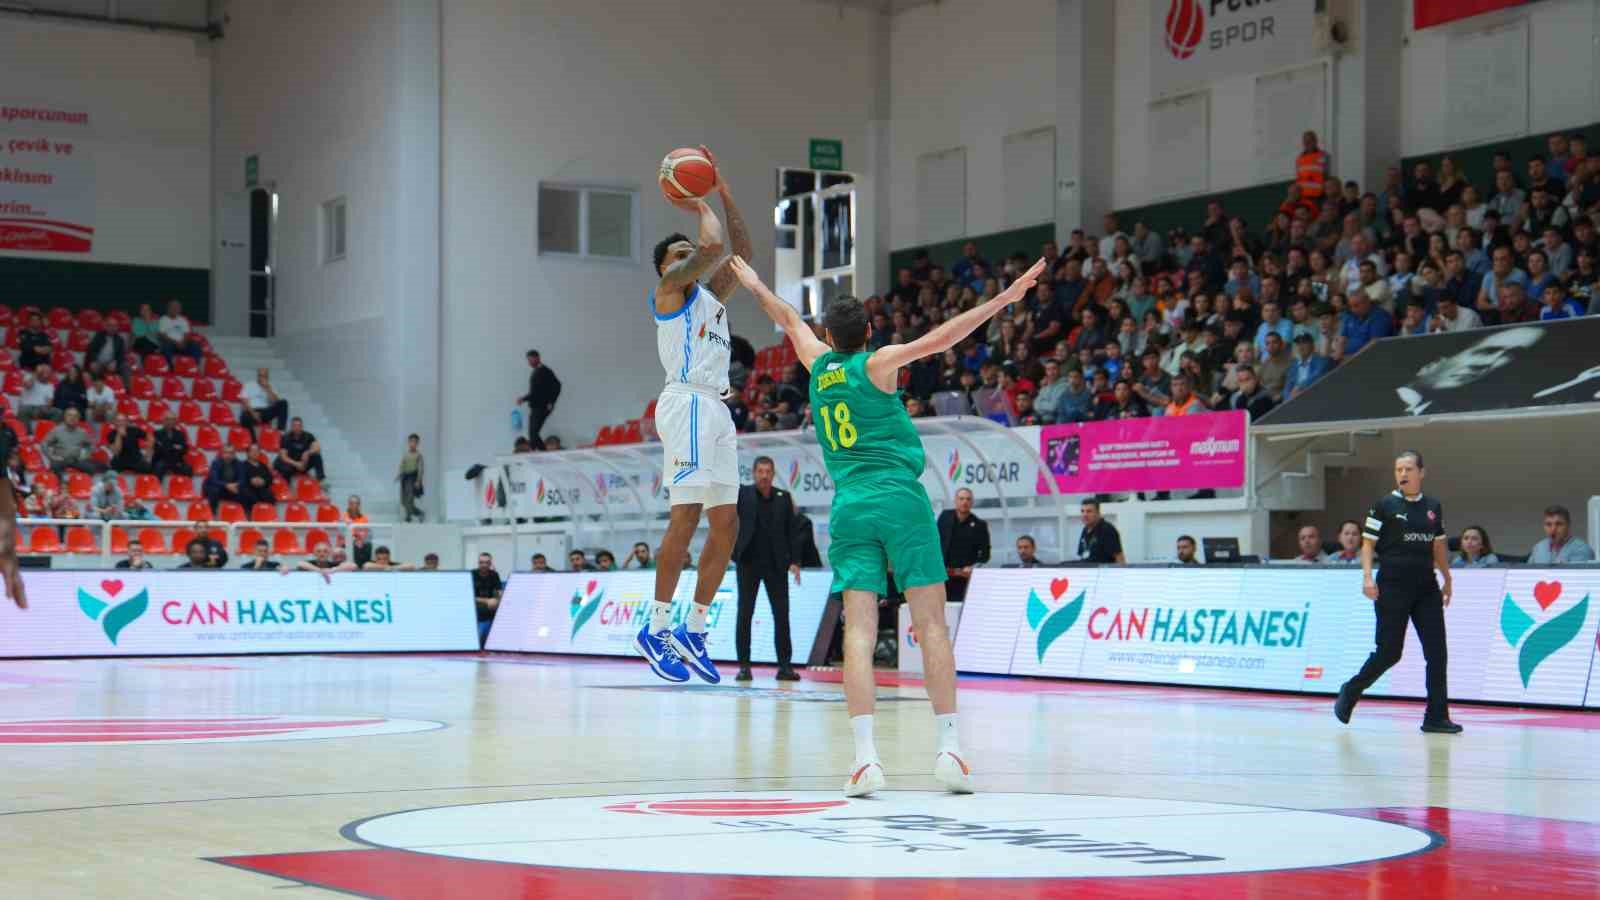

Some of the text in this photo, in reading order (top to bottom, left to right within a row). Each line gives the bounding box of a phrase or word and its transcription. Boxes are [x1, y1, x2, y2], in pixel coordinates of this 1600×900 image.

[1210, 16, 1275, 50] SPOR
[54, 141, 73, 155] ve
[820, 401, 857, 451] 18
[964, 462, 1020, 484] SOCAR
[162, 594, 393, 625] CAN HASTANESİ
[600, 601, 634, 625] CAN
[1088, 602, 1310, 648] CAN HASTANESİ
